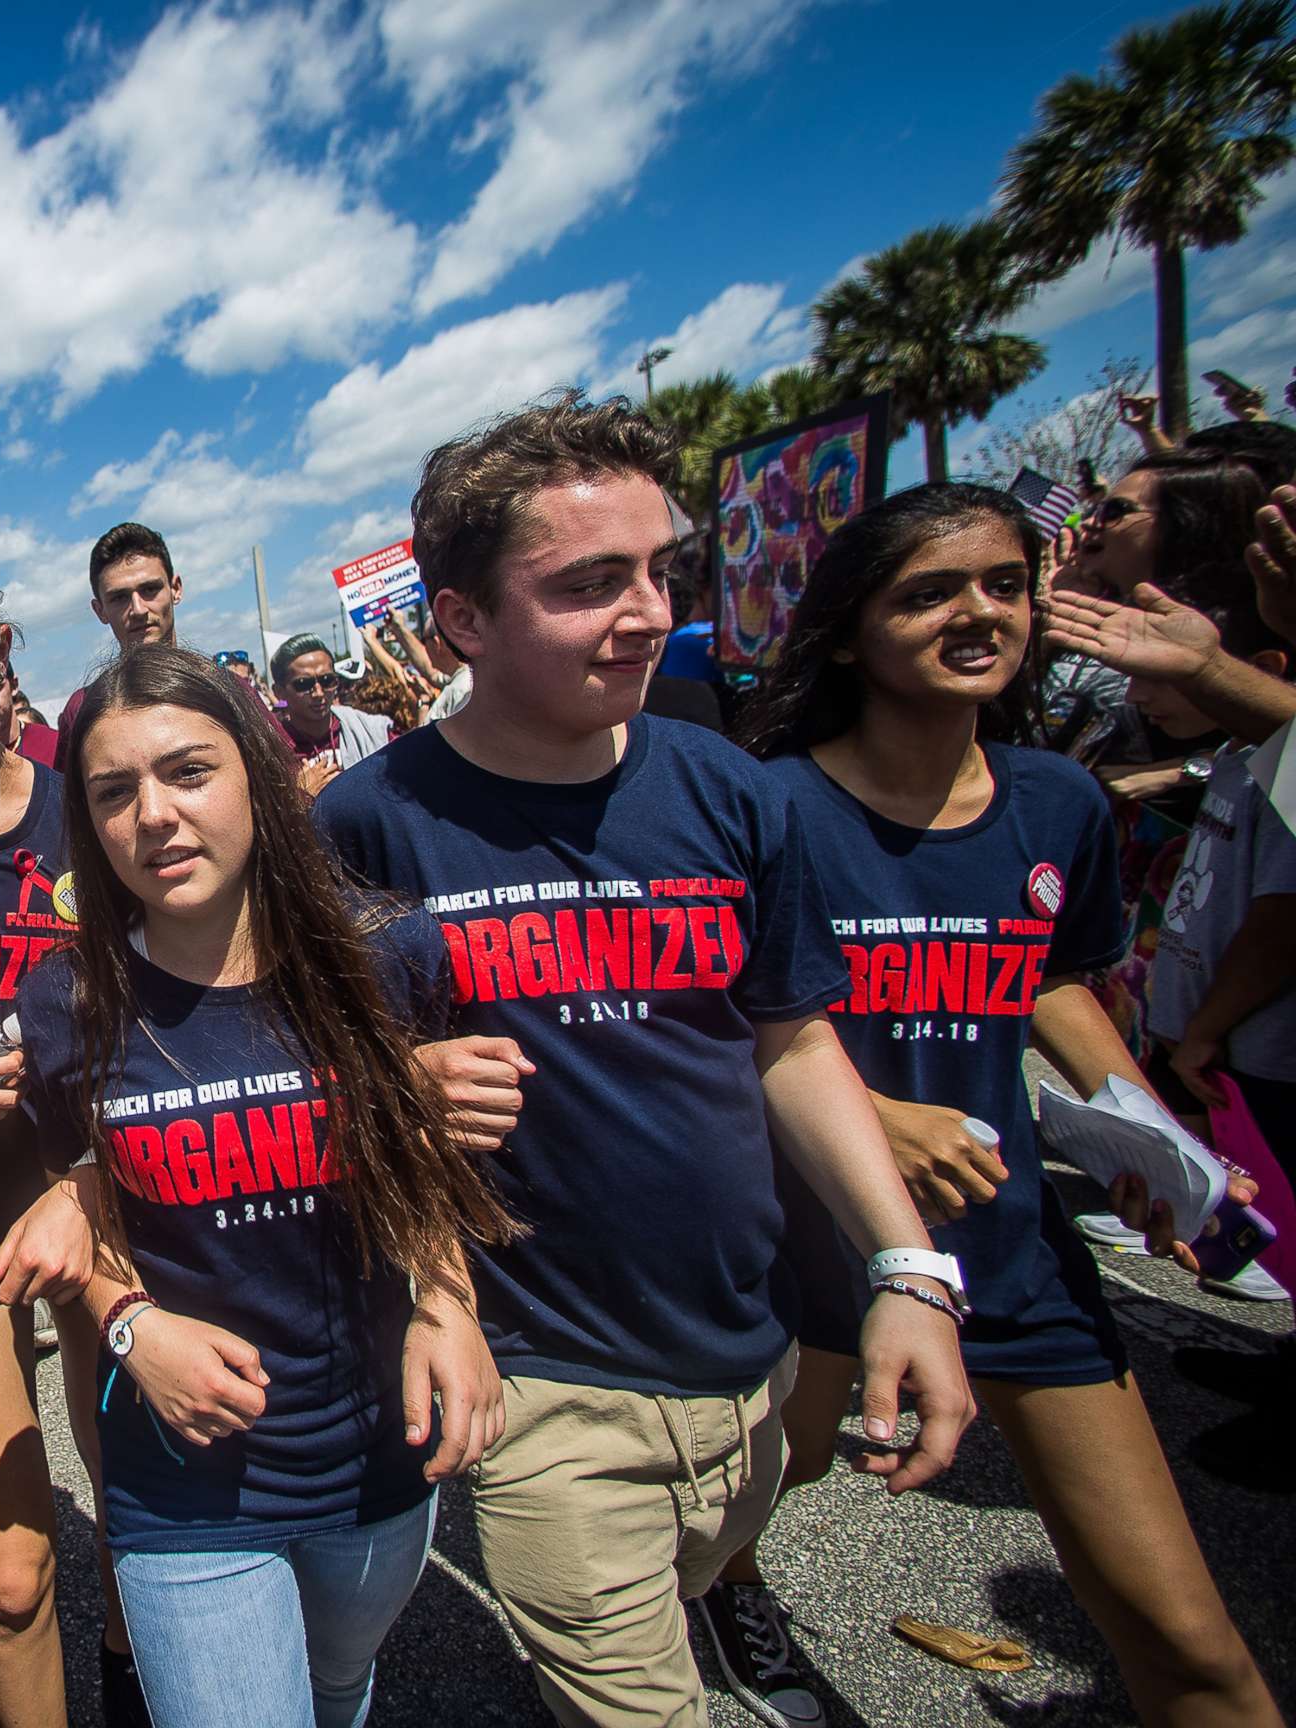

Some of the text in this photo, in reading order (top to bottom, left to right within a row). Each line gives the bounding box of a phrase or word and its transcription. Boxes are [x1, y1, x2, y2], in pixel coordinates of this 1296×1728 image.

[347, 590, 361, 601] NO
[384, 565, 417, 584] MONEY
[493, 883, 535, 905] FOR
[538, 880, 581, 900] OUR
[584, 879, 643, 898] LIVES
[649, 877, 747, 898] PARKLAND
[1032, 876, 1060, 914] PROUD
[861, 918, 900, 935] FOR
[930, 917, 988, 935] LIVES
[152, 1087, 195, 1112] FOR
[197, 1079, 241, 1105] OUR
[243, 1070, 304, 1096] LIVES
[215, 1194, 316, 1229] 3.24.18
